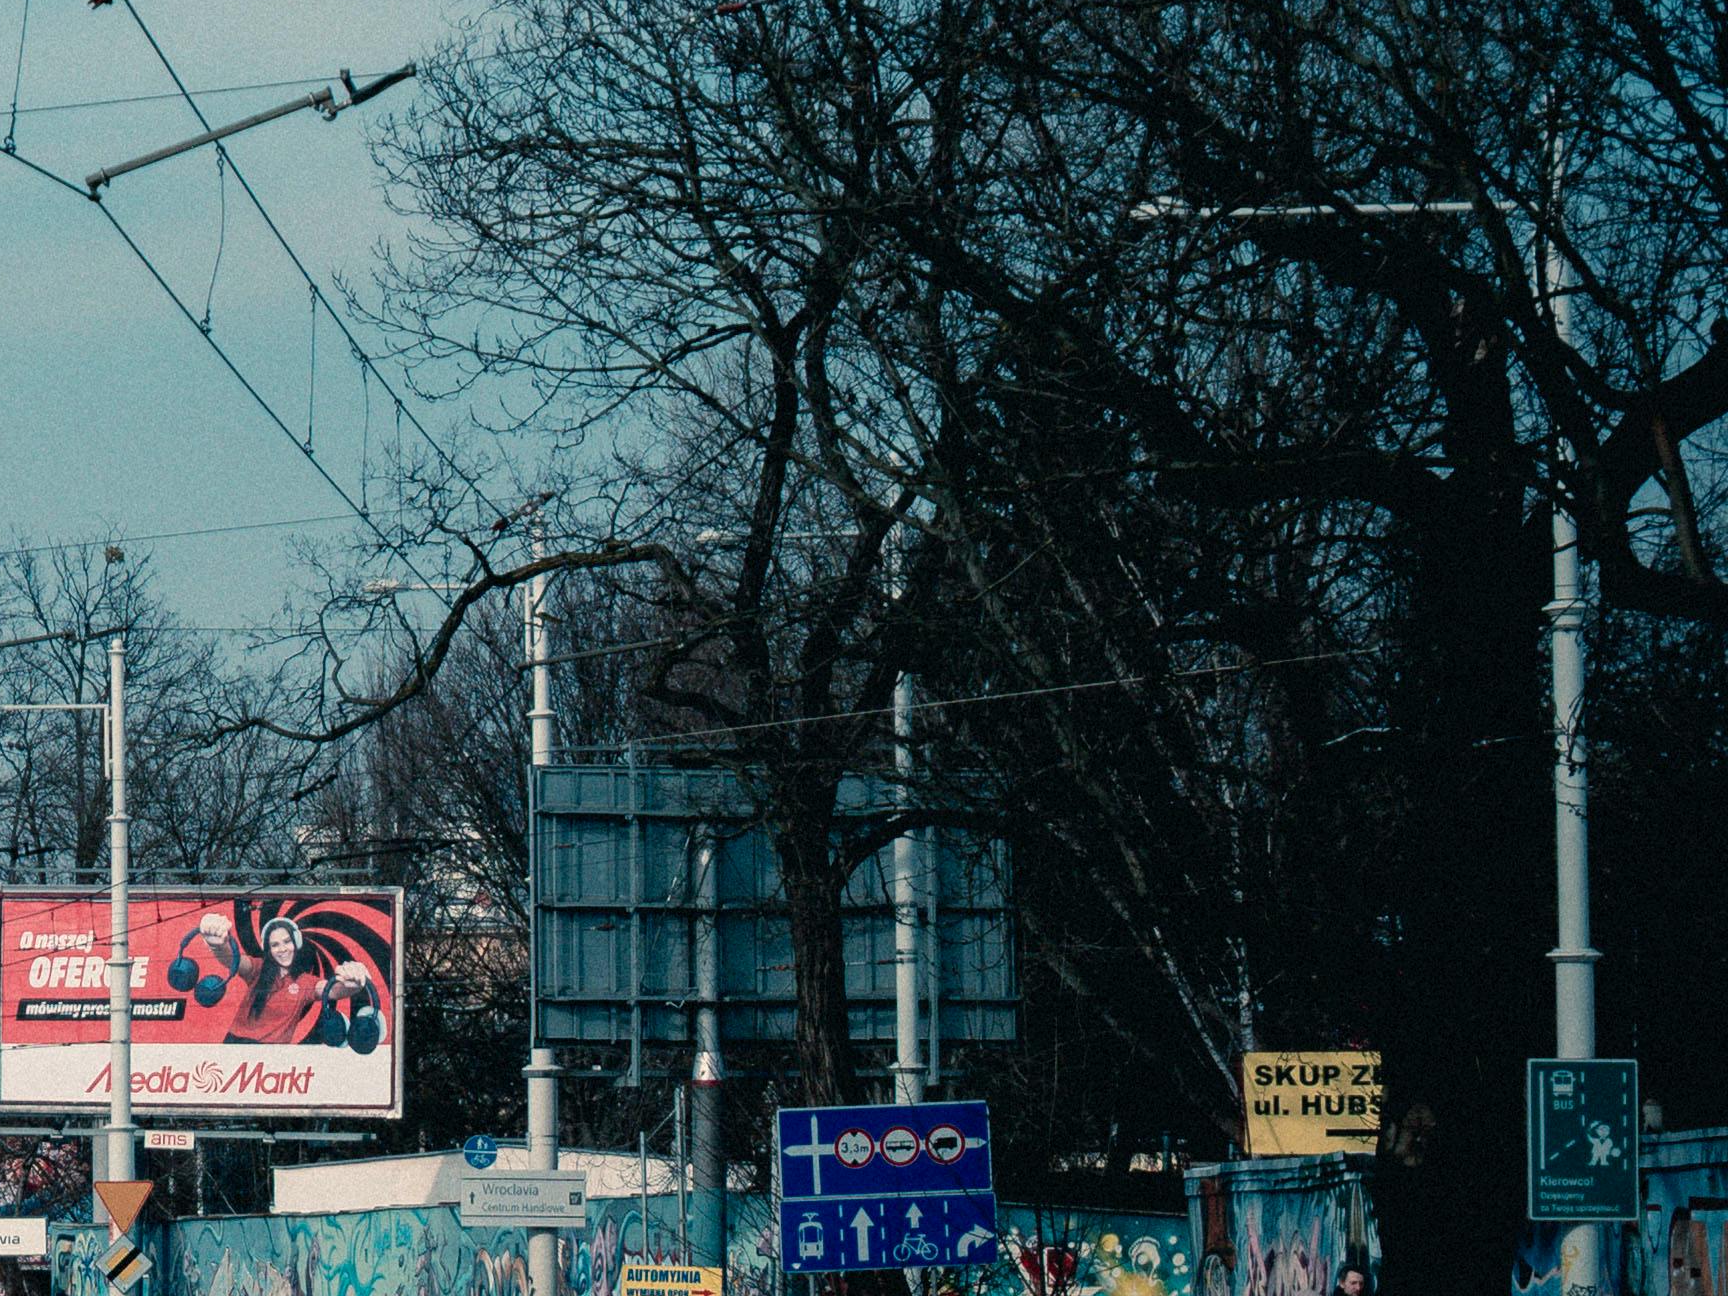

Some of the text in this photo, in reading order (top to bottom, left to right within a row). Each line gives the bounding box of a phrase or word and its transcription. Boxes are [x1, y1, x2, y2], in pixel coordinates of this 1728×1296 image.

[20, 930, 94, 953] O naszej
[219, 1061, 315, 1094] Markt
[1254, 1064, 1341, 1086] SKUP
[1254, 1095, 1289, 1116] ul.
[1553, 1100, 1574, 1110] BUS
[151, 1133, 187, 1146] ams
[482, 1183, 539, 1196] Wroclavia
